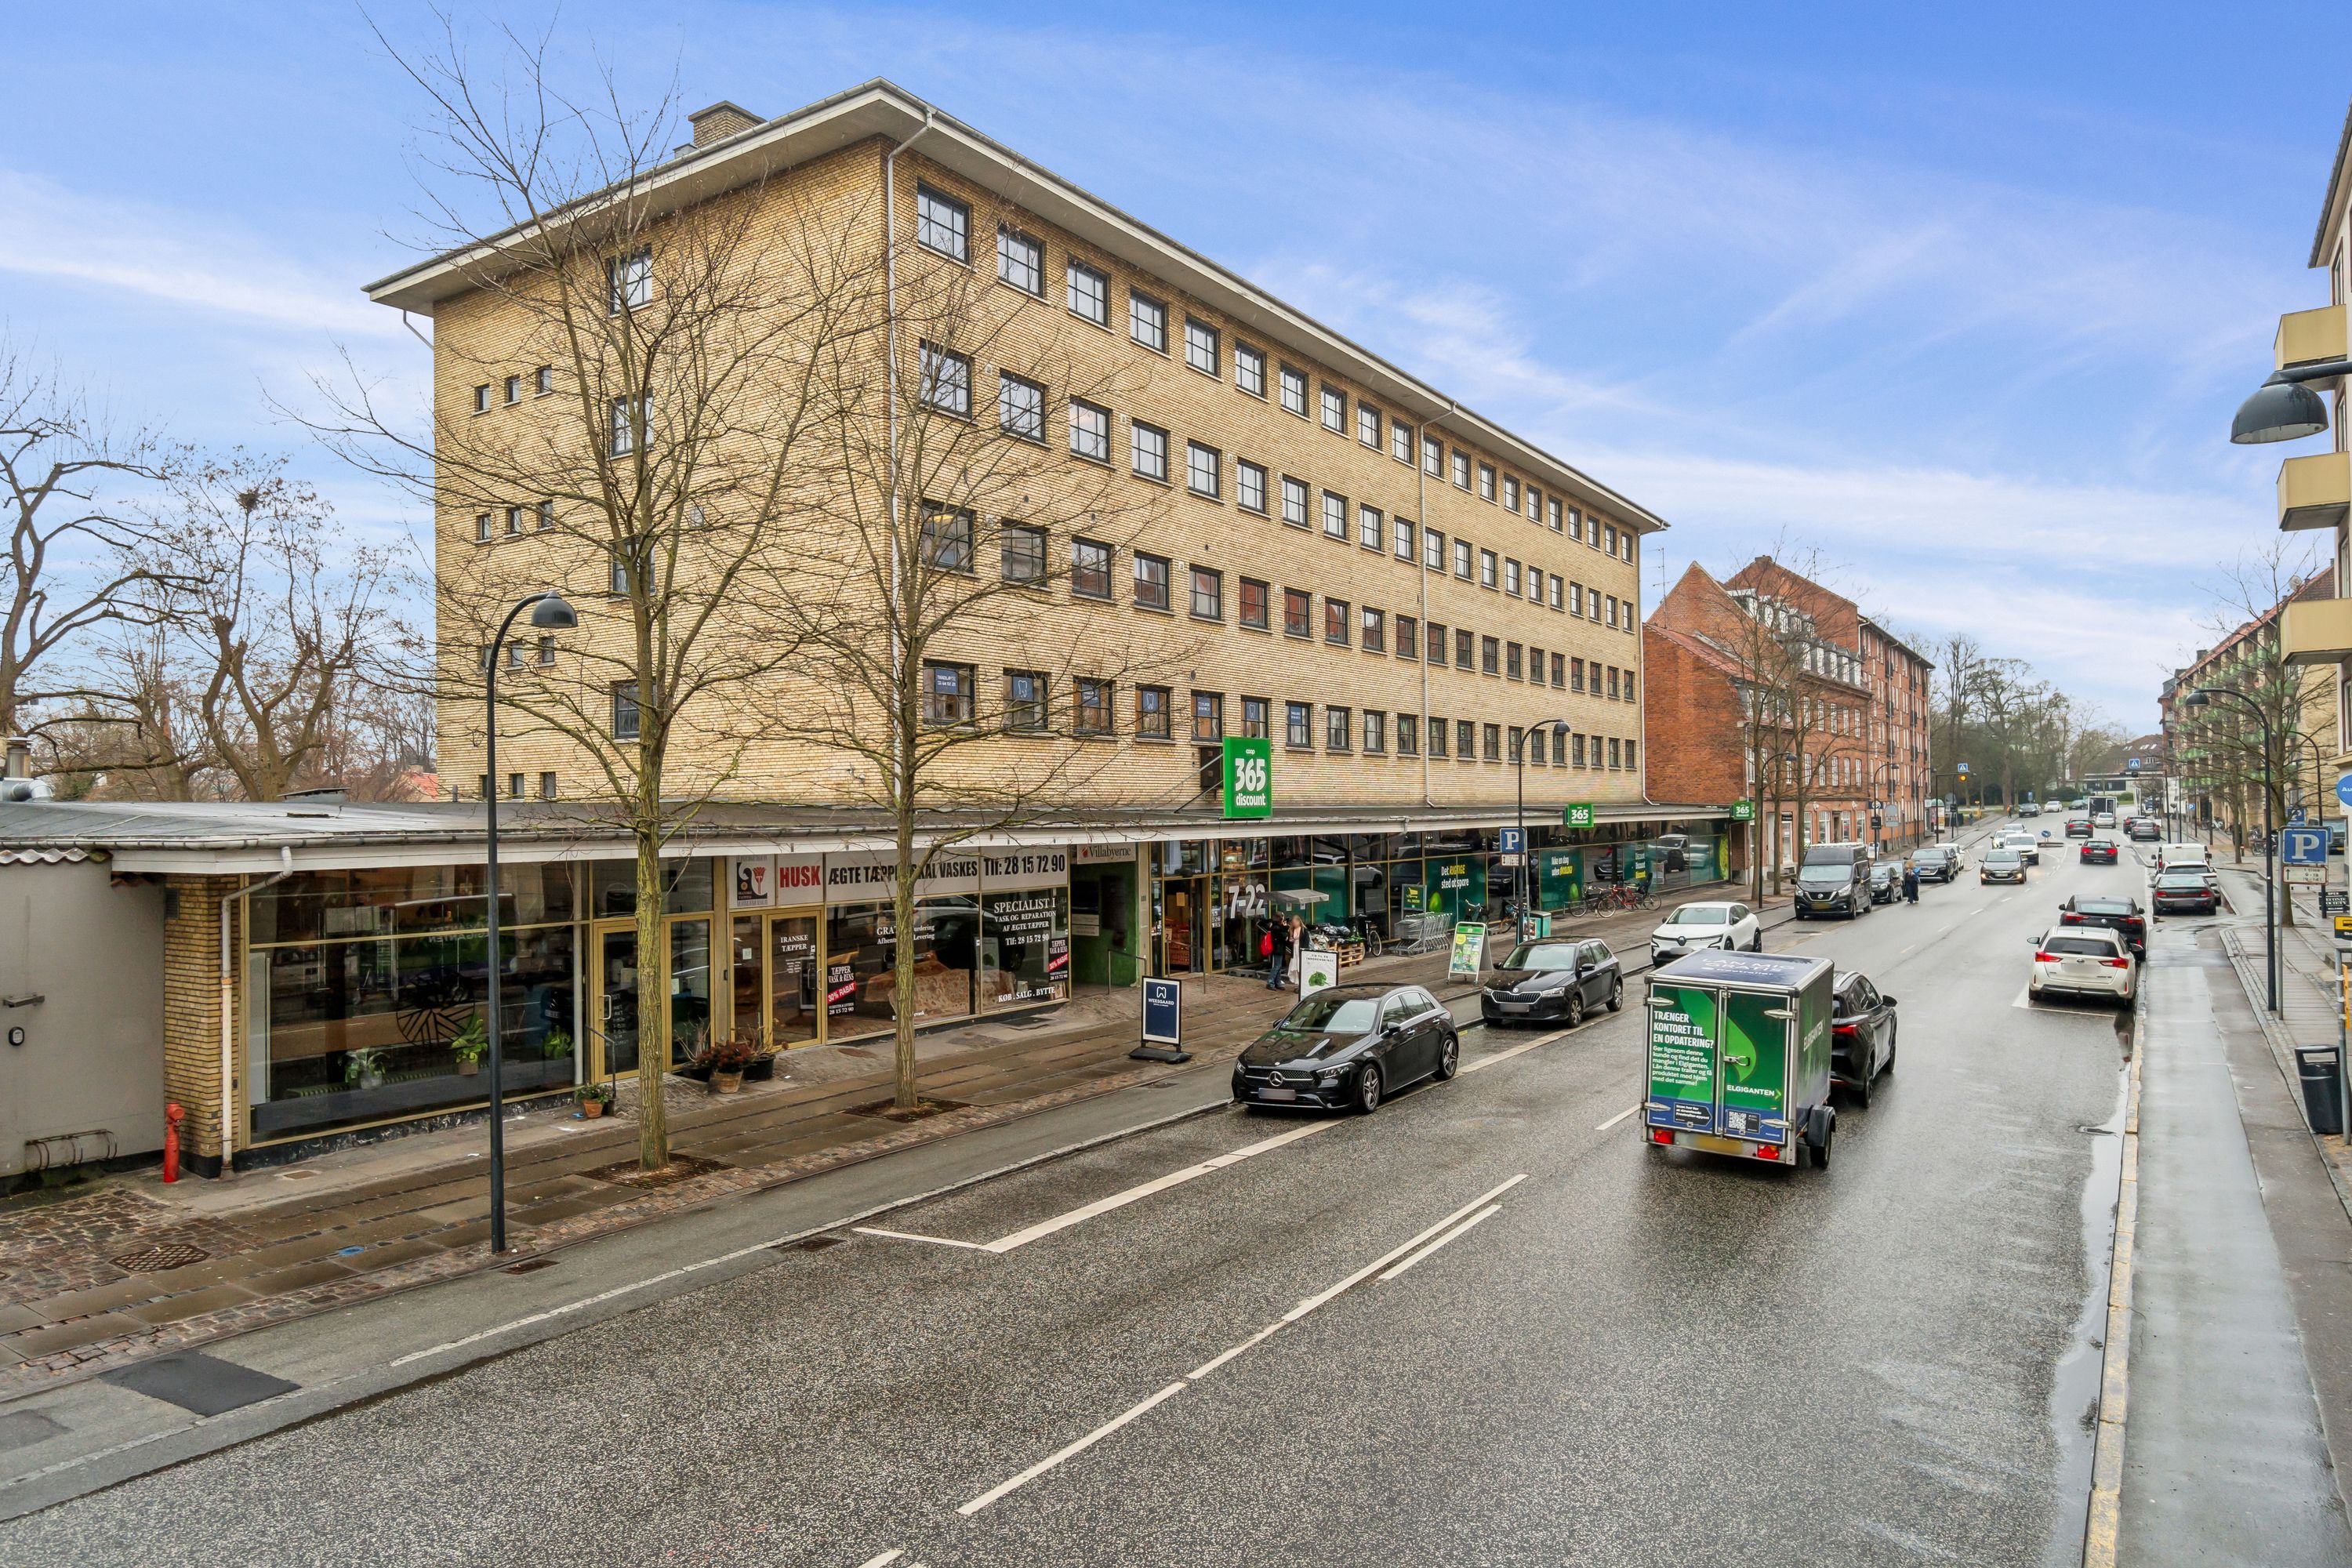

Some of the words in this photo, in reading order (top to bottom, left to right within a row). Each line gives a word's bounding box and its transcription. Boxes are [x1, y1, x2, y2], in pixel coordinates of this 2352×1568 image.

[1235, 758, 1266, 791] 365
[1236, 793, 1266, 806] discount
[1571, 809, 1588, 820] 365
[1505, 832, 1519, 850] P
[2292, 833, 2320, 859] P
[1088, 845, 1131, 860] Villabyerne
[984, 858, 1002, 876] Tlf:
[1004, 856, 1018, 875] 28
[1022, 855, 1034, 874] 15
[1037, 855, 1048, 873] 72
[1051, 855, 1065, 872] 90
[779, 866, 821, 887] HUSK
[828, 867, 861, 884] ÆGTE
[940, 861, 978, 878] VASKES
[1441, 878, 1450, 888] sted
[1451, 878, 1457, 887] at
[1457, 878, 1469, 889] spare
[994, 898, 1051, 913] SPECIALIST
[1052, 898, 1056, 908] I
[1229, 884, 1265, 919] 7-22
[1021, 910, 1056, 920] REPARATION
[1028, 920, 1049, 929] TÆPPER
[780, 934, 808, 943] IRANSKE
[1005, 937, 1017, 946] Tlf:
[782, 943, 808, 952] TÆPPER
[831, 965, 851, 975] TÆPPER
[828, 975, 839, 983] VASK
[844, 973, 854, 982] RENS
[828, 991, 839, 1002] 30%
[839, 983, 855, 996] RABAT
[998, 993, 1012, 1003] KØB
[1015, 990, 1032, 999] SALG
[1036, 986, 1055, 996] BYTTE
[1653, 1011, 1689, 1023] TRÆNGER
[1653, 1022, 1691, 1034] KONTORET
[1692, 1025, 1704, 1036] TIL
[1653, 1033, 1663, 1044] EN
[1664, 1034, 1715, 1049] OPDATERING?
[1679, 1060, 1710, 1069] Elgiganten.
[1726, 1084, 1775, 1096] ELGIGANTEN
